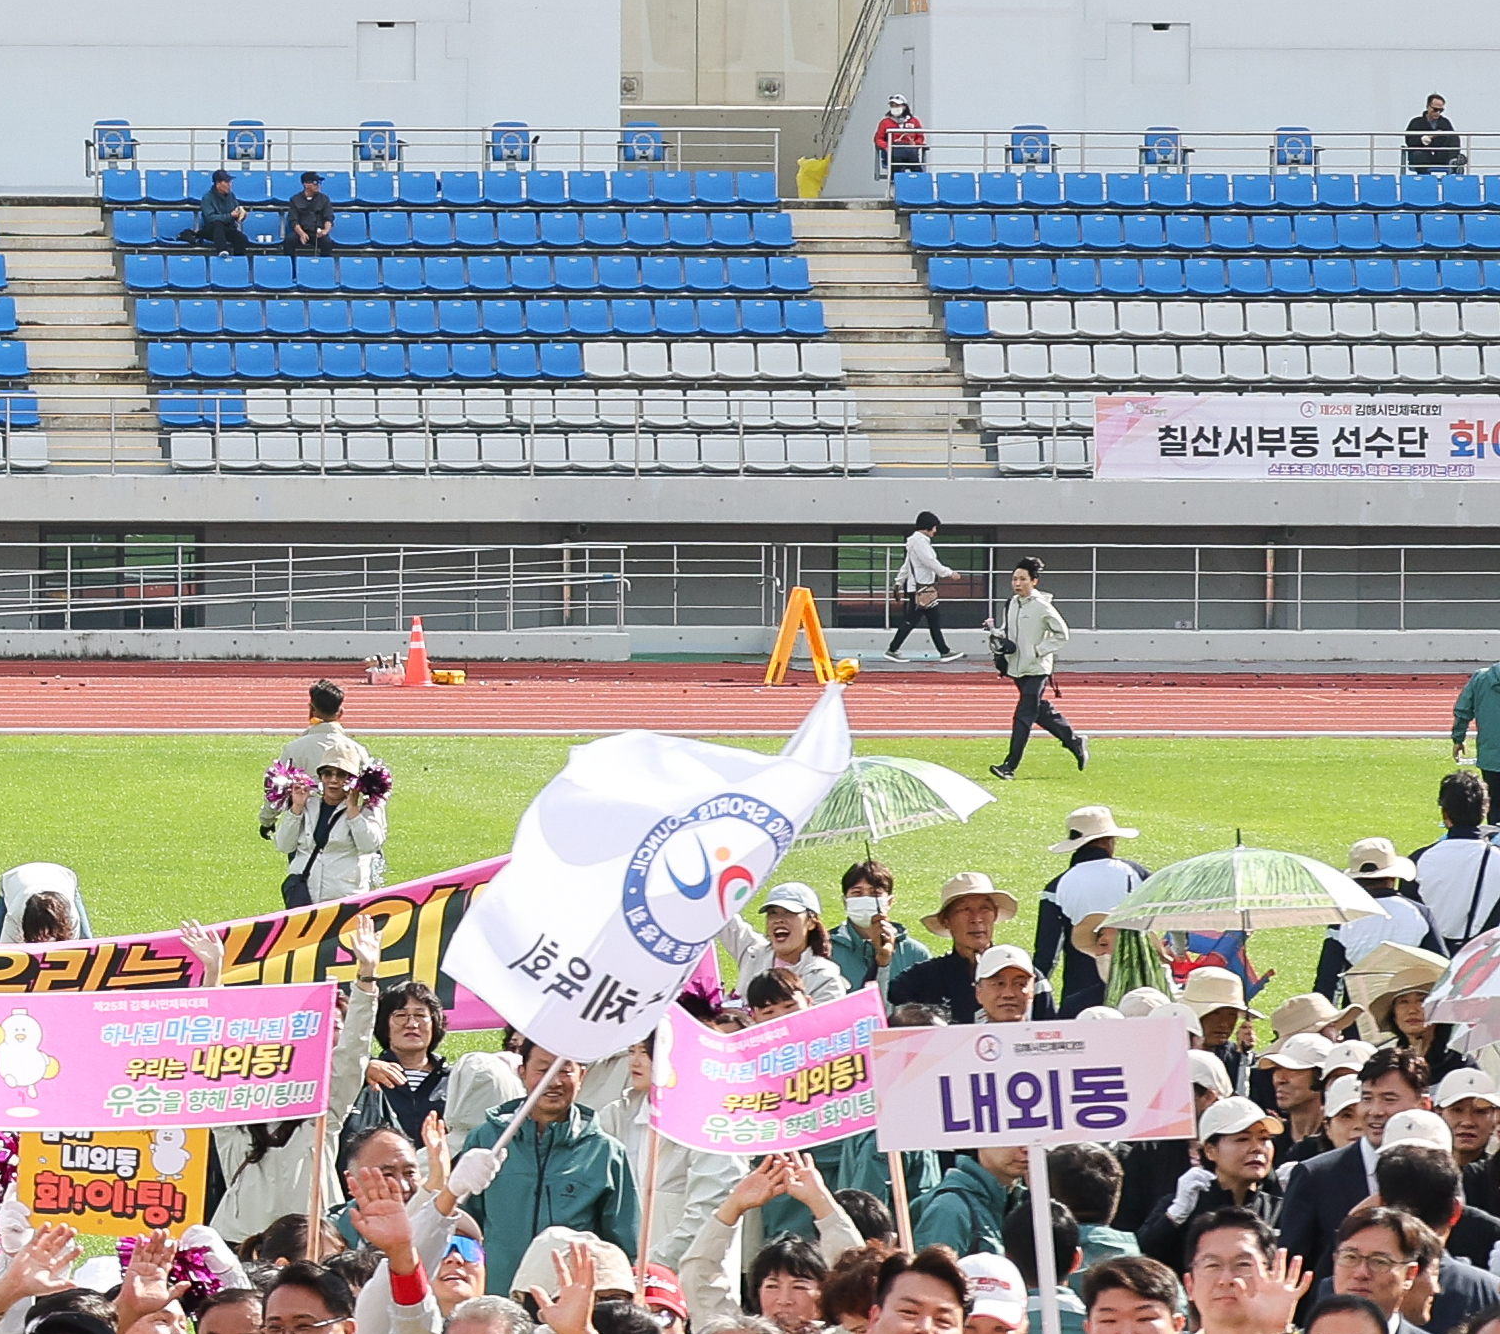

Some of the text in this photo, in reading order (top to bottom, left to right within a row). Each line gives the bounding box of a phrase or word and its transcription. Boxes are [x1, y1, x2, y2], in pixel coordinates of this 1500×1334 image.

[1355, 403, 1443, 417] 김해시민체육대회
[1157, 424, 1320, 459] 칠산서부동
[1332, 424, 1429, 459] 선수단
[220, 883, 500, 1005] 내외
[101, 1010, 322, 1046] 하나된 마음! 하나된 힘!
[125, 1043, 294, 1080] 우리는 내외동!
[701, 1058, 757, 1081] 하나된
[758, 1042, 806, 1076] 마음!
[808, 1031, 853, 1062] 하나된
[103, 1081, 316, 1118] 우승을 향해 화이팅!!!
[721, 1054, 866, 1113] 우리는 내외동!
[938, 1066, 1129, 1134] 내외동
[702, 1115, 780, 1143] 우승을
[783, 1110, 821, 1137] 향해
[61, 1144, 140, 1178] 내외동
[33, 1170, 187, 1227] 화!이!팅!
